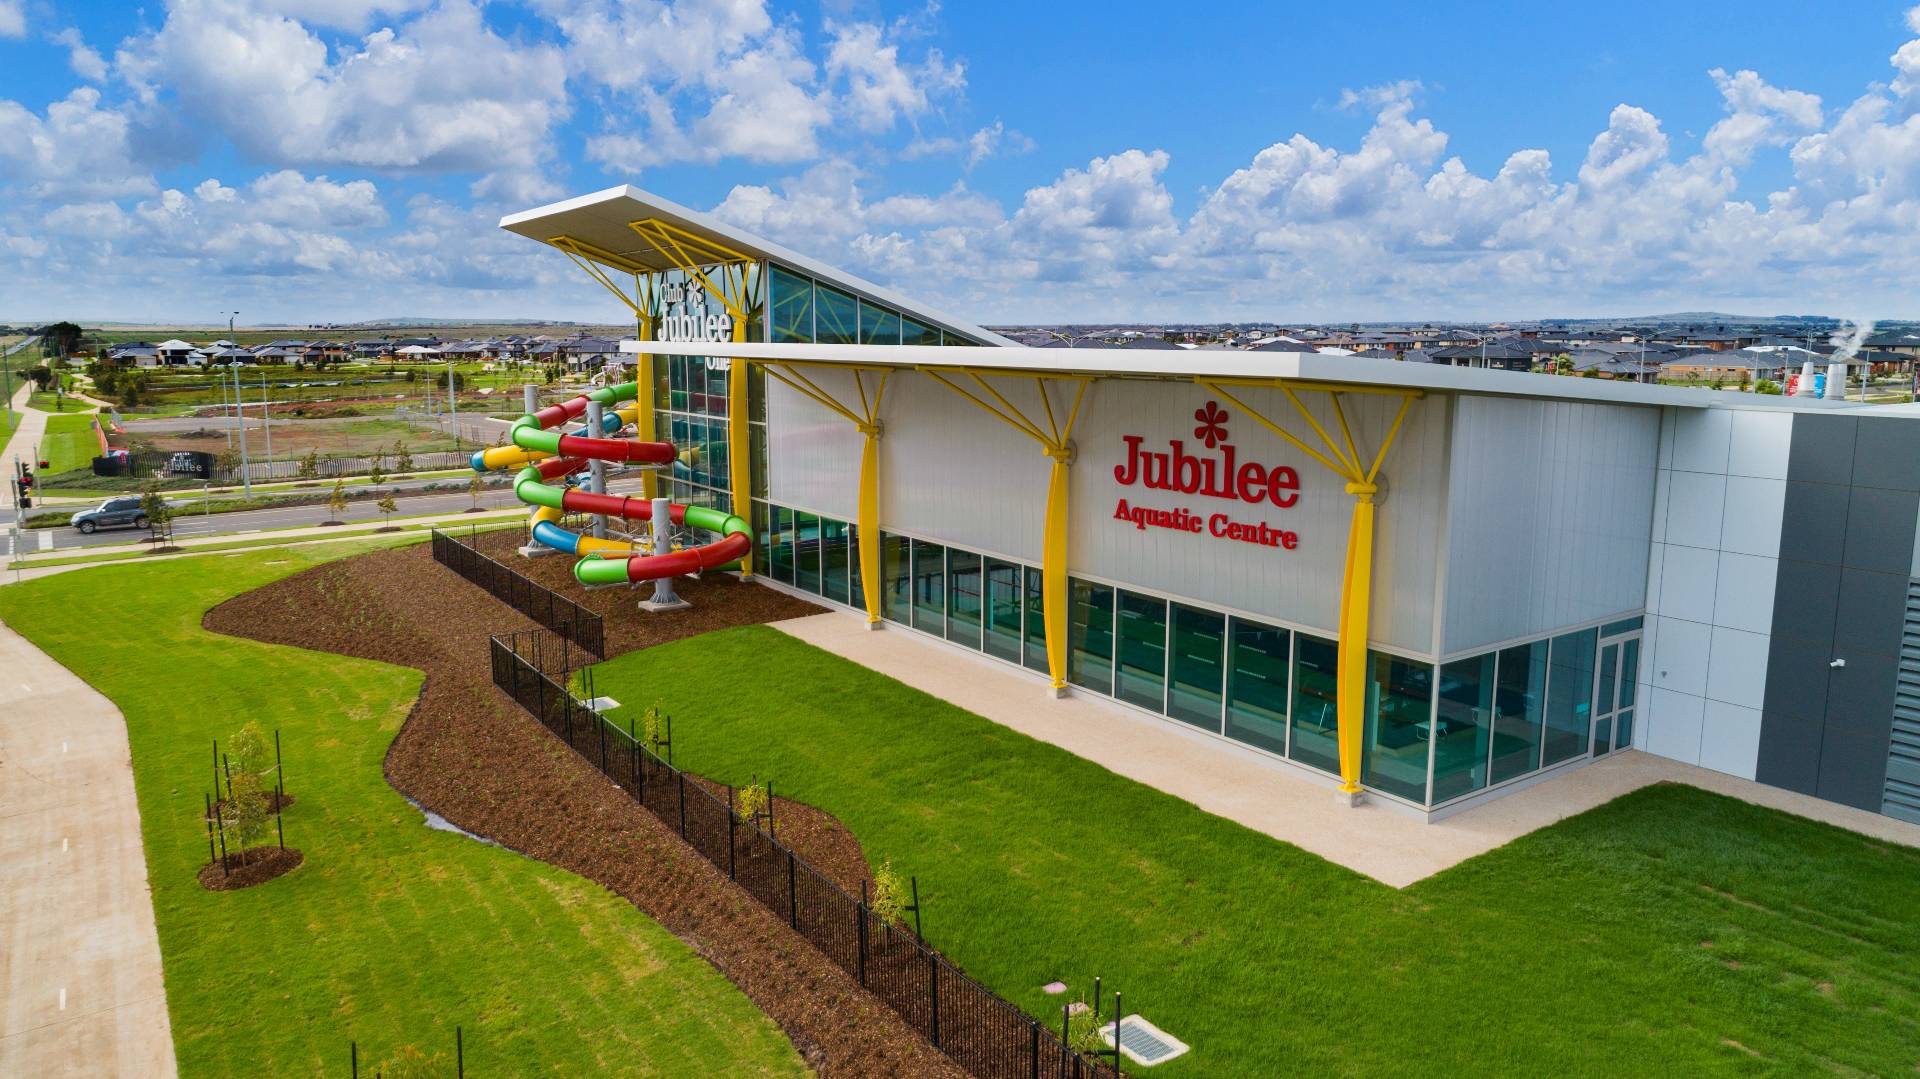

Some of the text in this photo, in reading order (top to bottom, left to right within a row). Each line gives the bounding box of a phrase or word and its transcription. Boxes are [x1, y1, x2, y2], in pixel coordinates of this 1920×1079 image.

[659, 283, 684, 303] Club
[657, 304, 732, 342] Jubilee
[1113, 434, 1300, 508] Jubilee
[1113, 498, 1298, 550] Aquatic Centre
